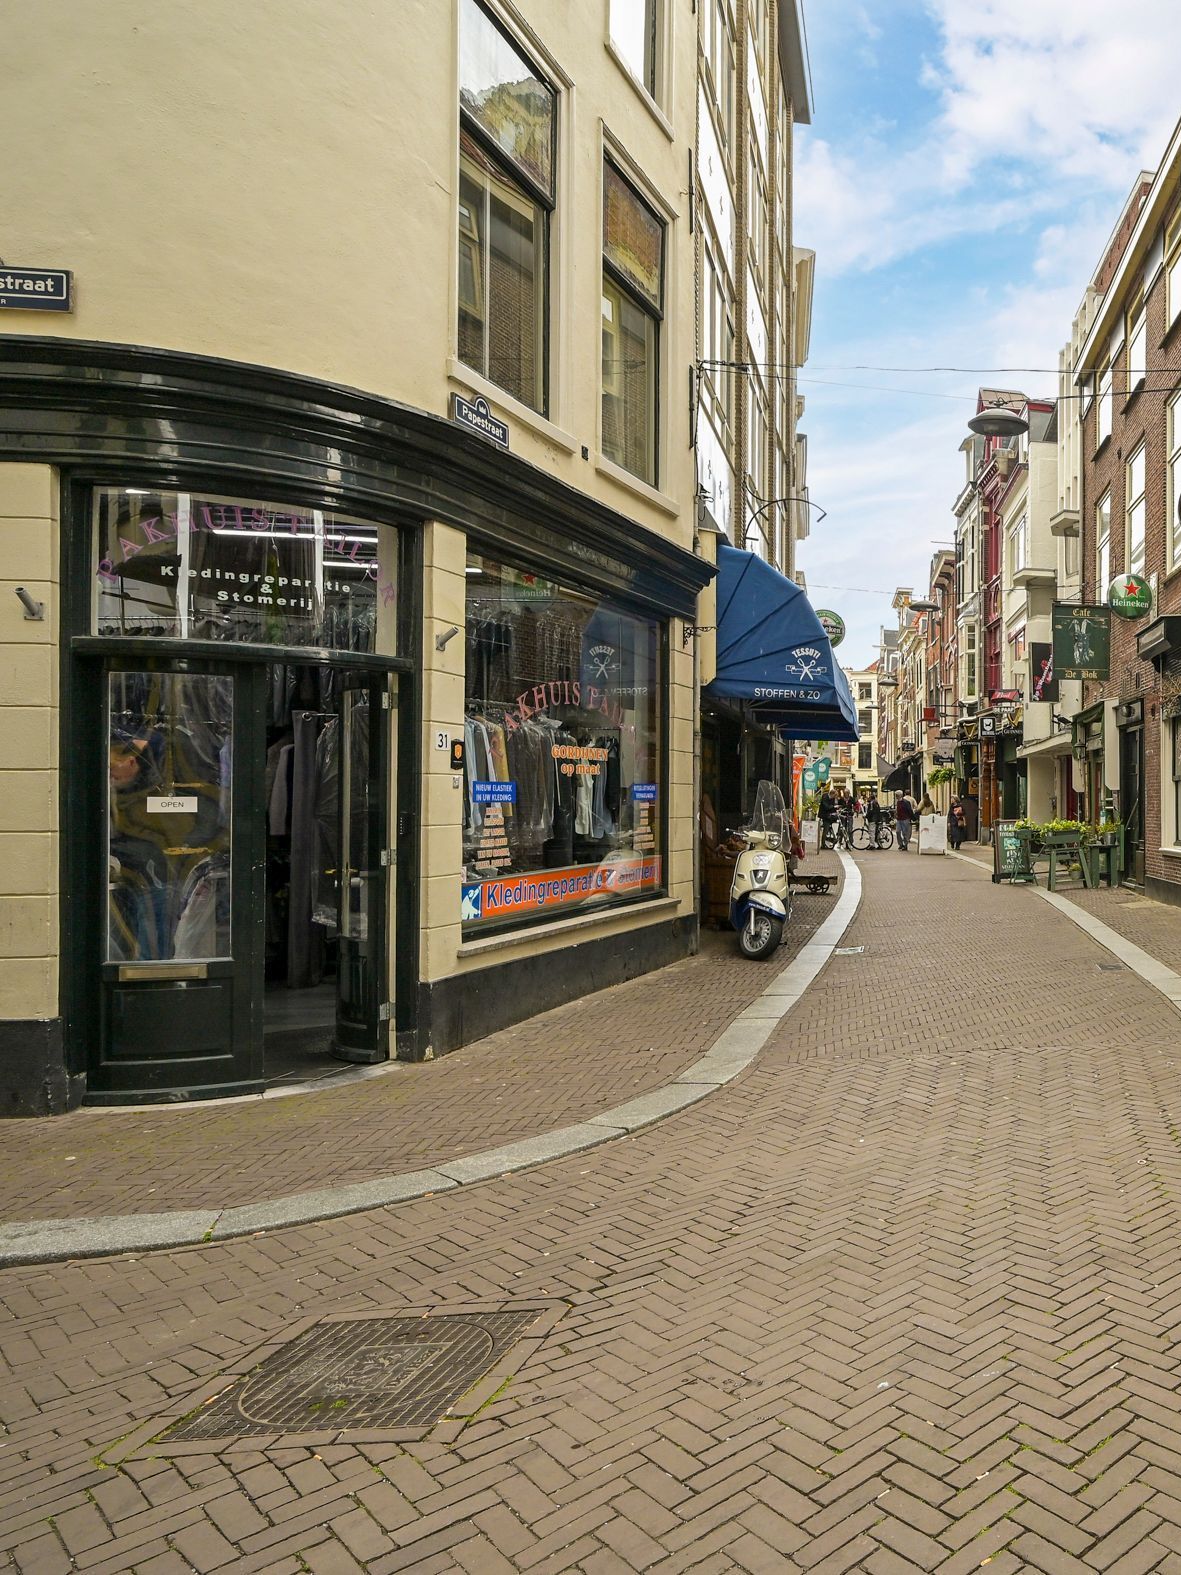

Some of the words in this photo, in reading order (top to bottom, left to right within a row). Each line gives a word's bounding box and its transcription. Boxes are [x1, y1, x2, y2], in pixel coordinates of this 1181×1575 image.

[0, 275, 54, 292] straat
[462, 404, 503, 439] Papestraat
[260, 583, 273, 594] &
[217, 590, 314, 611] Stomerij
[1112, 598, 1150, 609] Heineken
[791, 647, 822, 659] TESSUTI
[754, 687, 797, 699] STOFFEN
[798, 691, 806, 699] &
[807, 690, 821, 700] ZO
[437, 733, 448, 748] 31
[551, 744, 608, 761] GORDIJNEN
[561, 763, 574, 777] op
[576, 763, 600, 775] maat
[486, 869, 603, 909] Kledingreparatie
